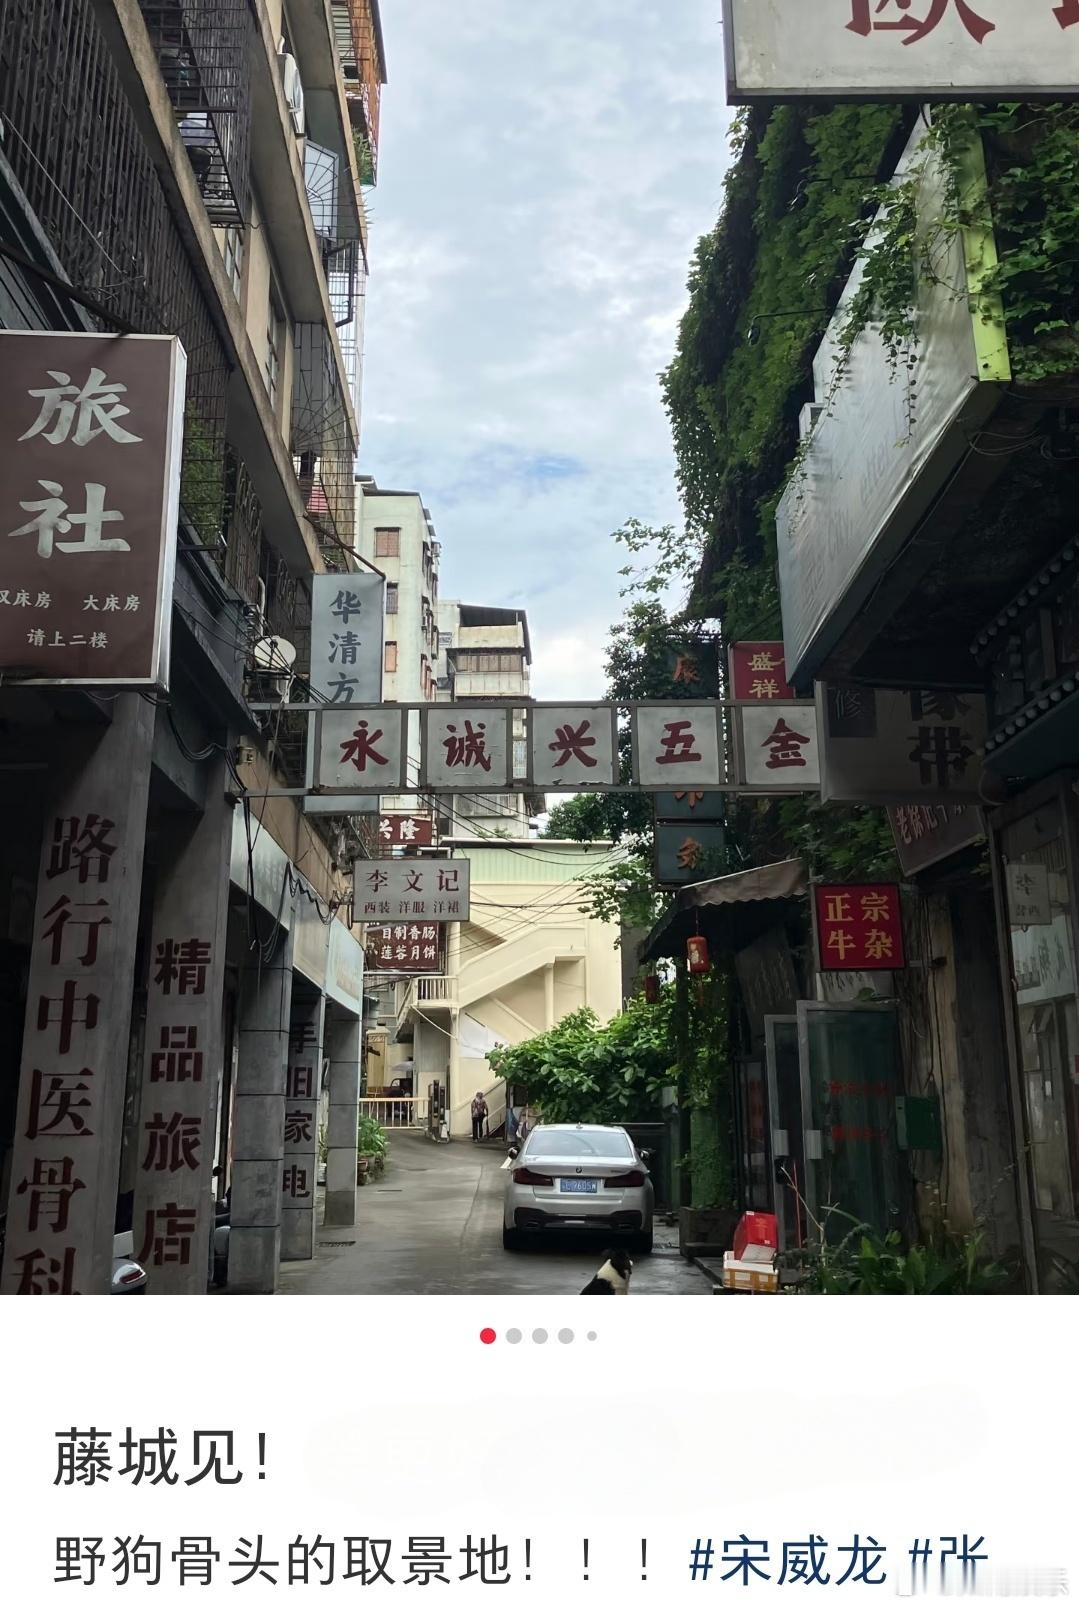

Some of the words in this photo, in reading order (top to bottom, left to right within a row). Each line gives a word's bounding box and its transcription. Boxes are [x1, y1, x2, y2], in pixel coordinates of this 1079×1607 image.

[8, 367, 143, 560] 旅社
[82, 594, 141, 612] 大床房
[26, 628, 109, 649] 请上二楼
[327, 590, 362, 703] 华清方
[747, 652, 784, 699] 盛祥
[339, 717, 811, 771] 永诚兴五金
[365, 868, 460, 894] 李文记
[364, 901, 391, 914] 西装
[398, 901, 425, 914] 洋服
[825, 891, 890, 924] 正宗
[827, 928, 894, 961] 牛杂
[10, 814, 118, 1294] 路行中医骨科
[137, 938, 212, 1266] 精品旅店
